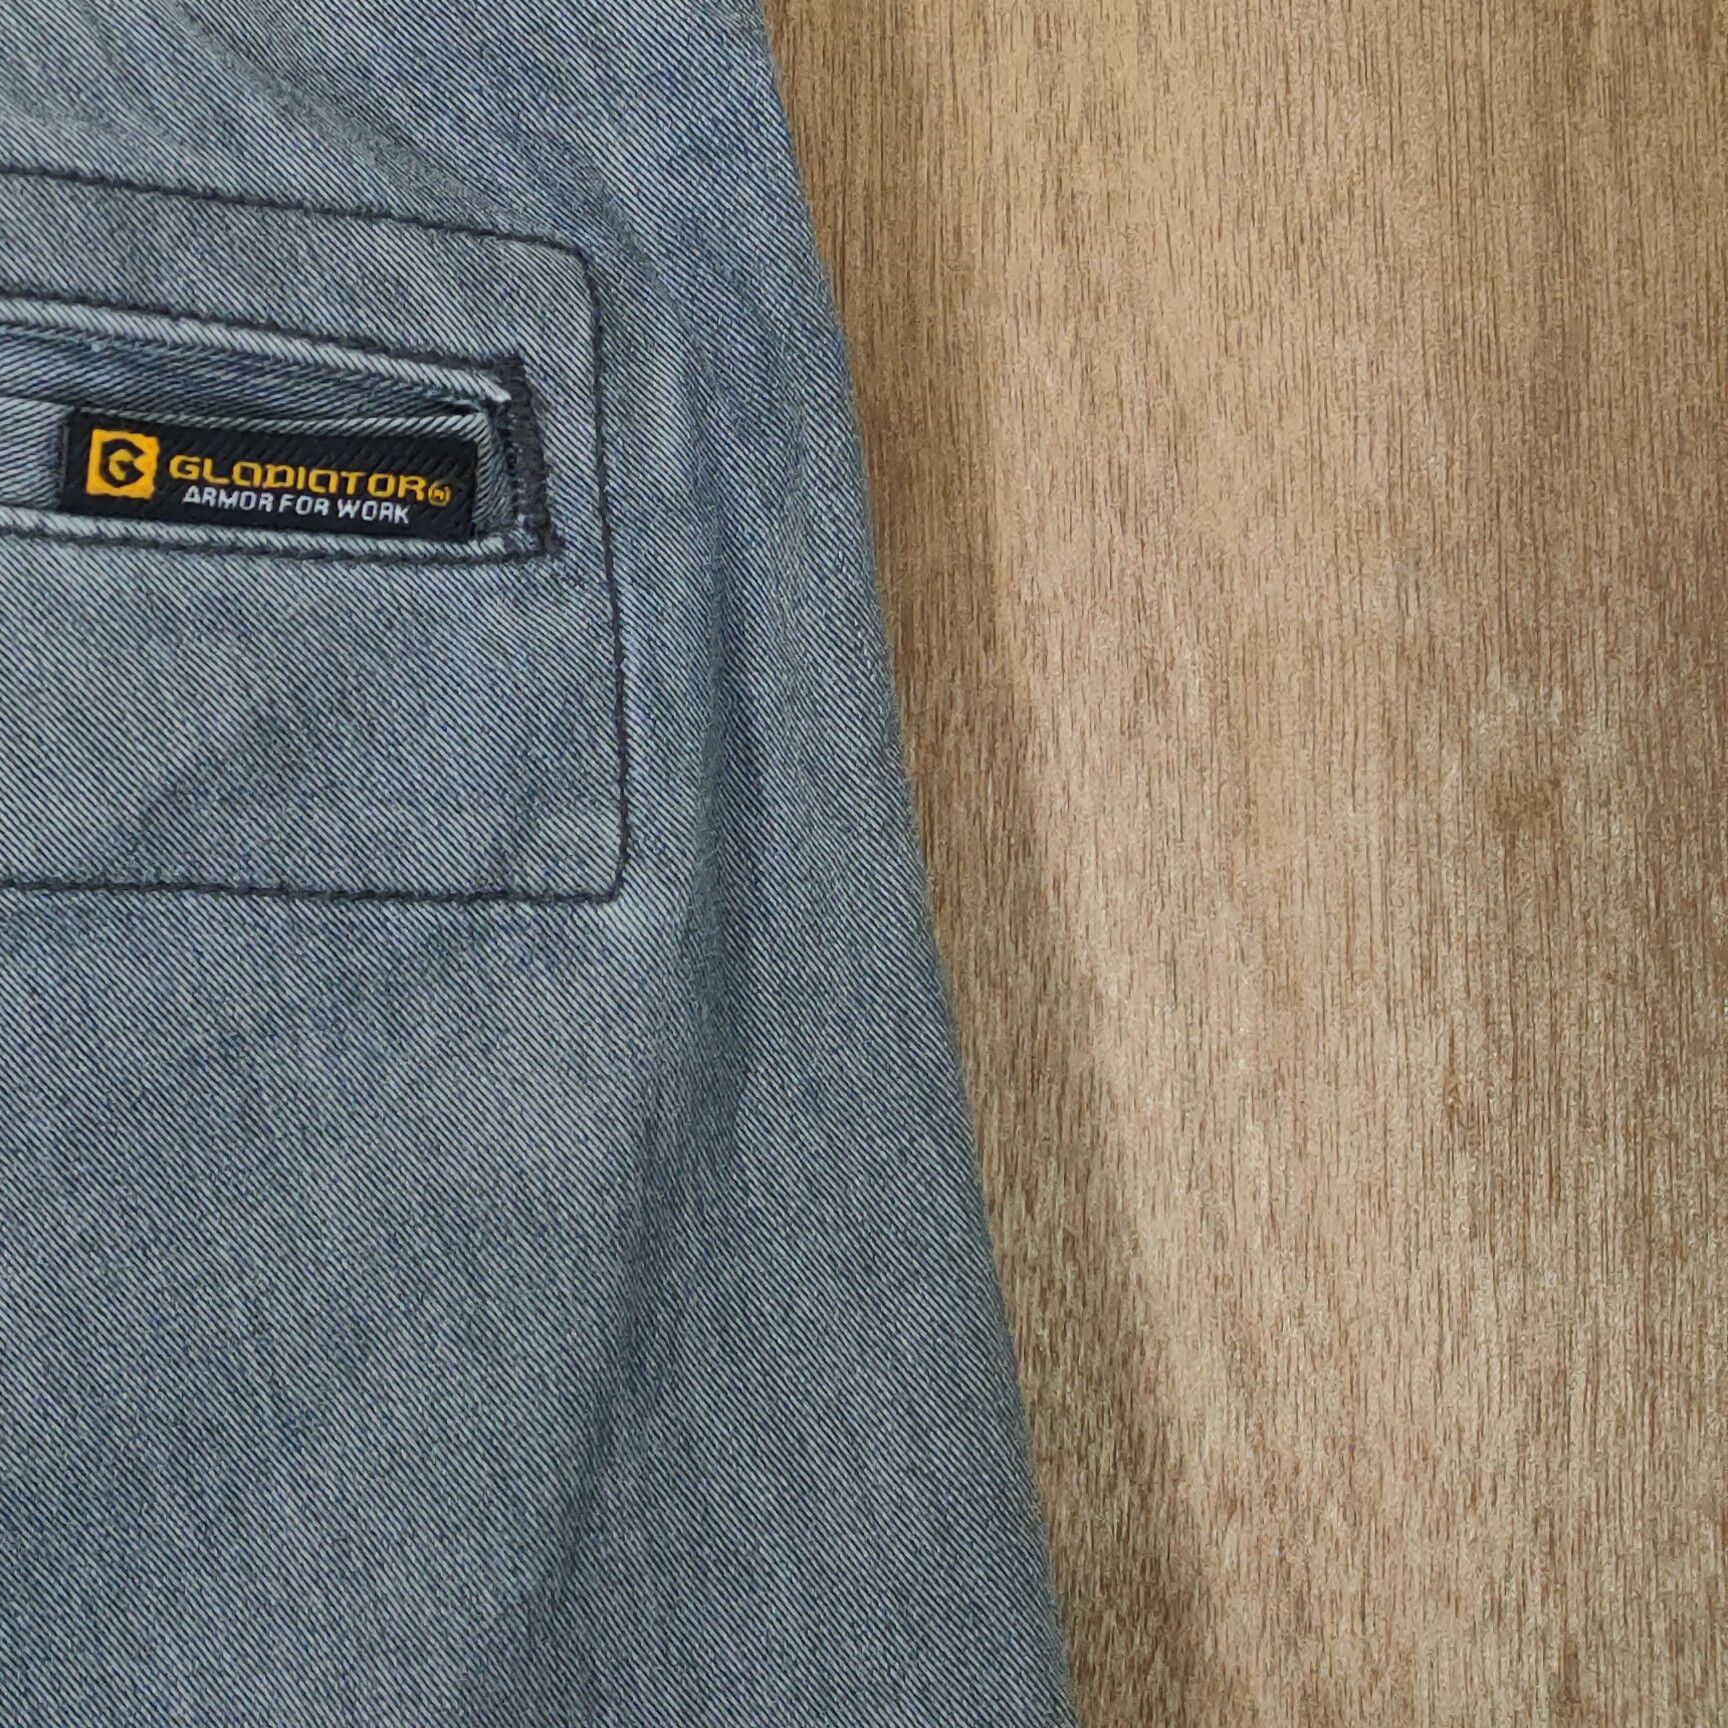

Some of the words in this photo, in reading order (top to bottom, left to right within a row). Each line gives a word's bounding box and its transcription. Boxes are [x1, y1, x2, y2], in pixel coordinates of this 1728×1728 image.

[182, 485, 273, 513] ARMOR
[278, 490, 329, 516] FOR
[336, 499, 410, 524] WORK
